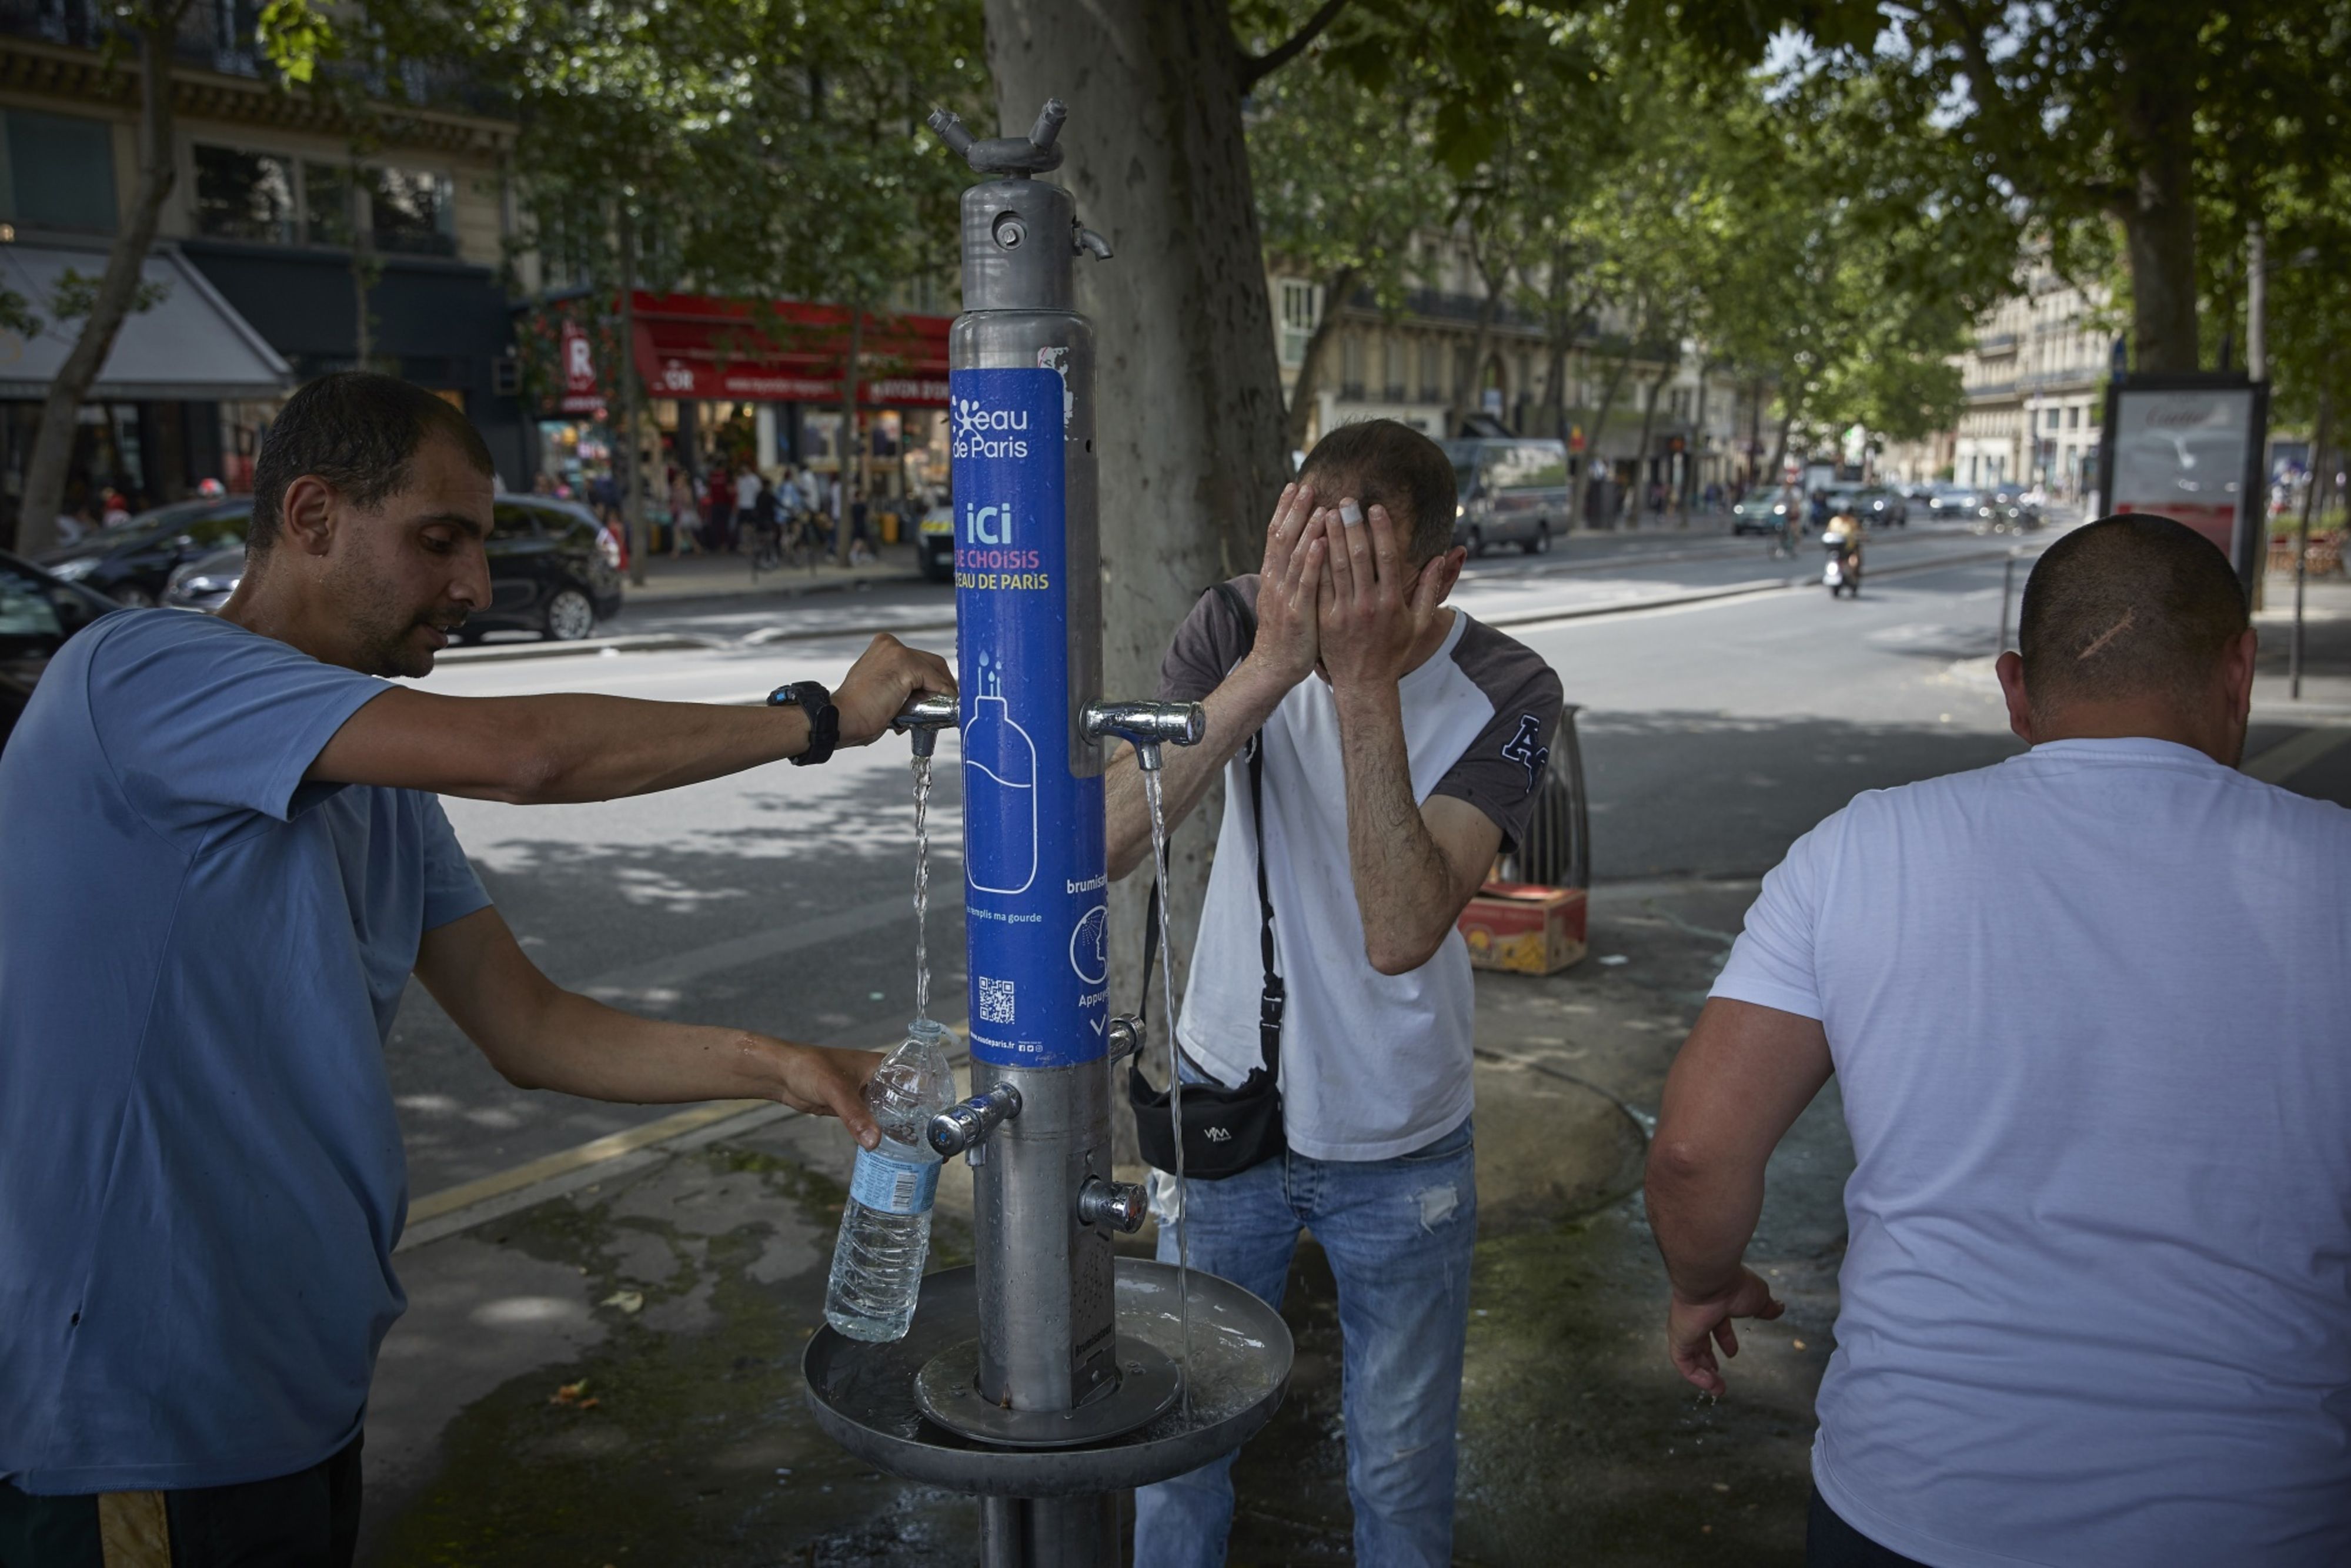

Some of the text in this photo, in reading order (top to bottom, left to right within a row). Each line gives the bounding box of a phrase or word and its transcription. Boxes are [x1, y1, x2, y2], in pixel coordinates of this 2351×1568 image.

[953, 435, 1028, 458] de Paris
[979, 573, 998, 590] DE
[994, 912, 1006, 921] ma
[1008, 912, 1042, 924] gourde
